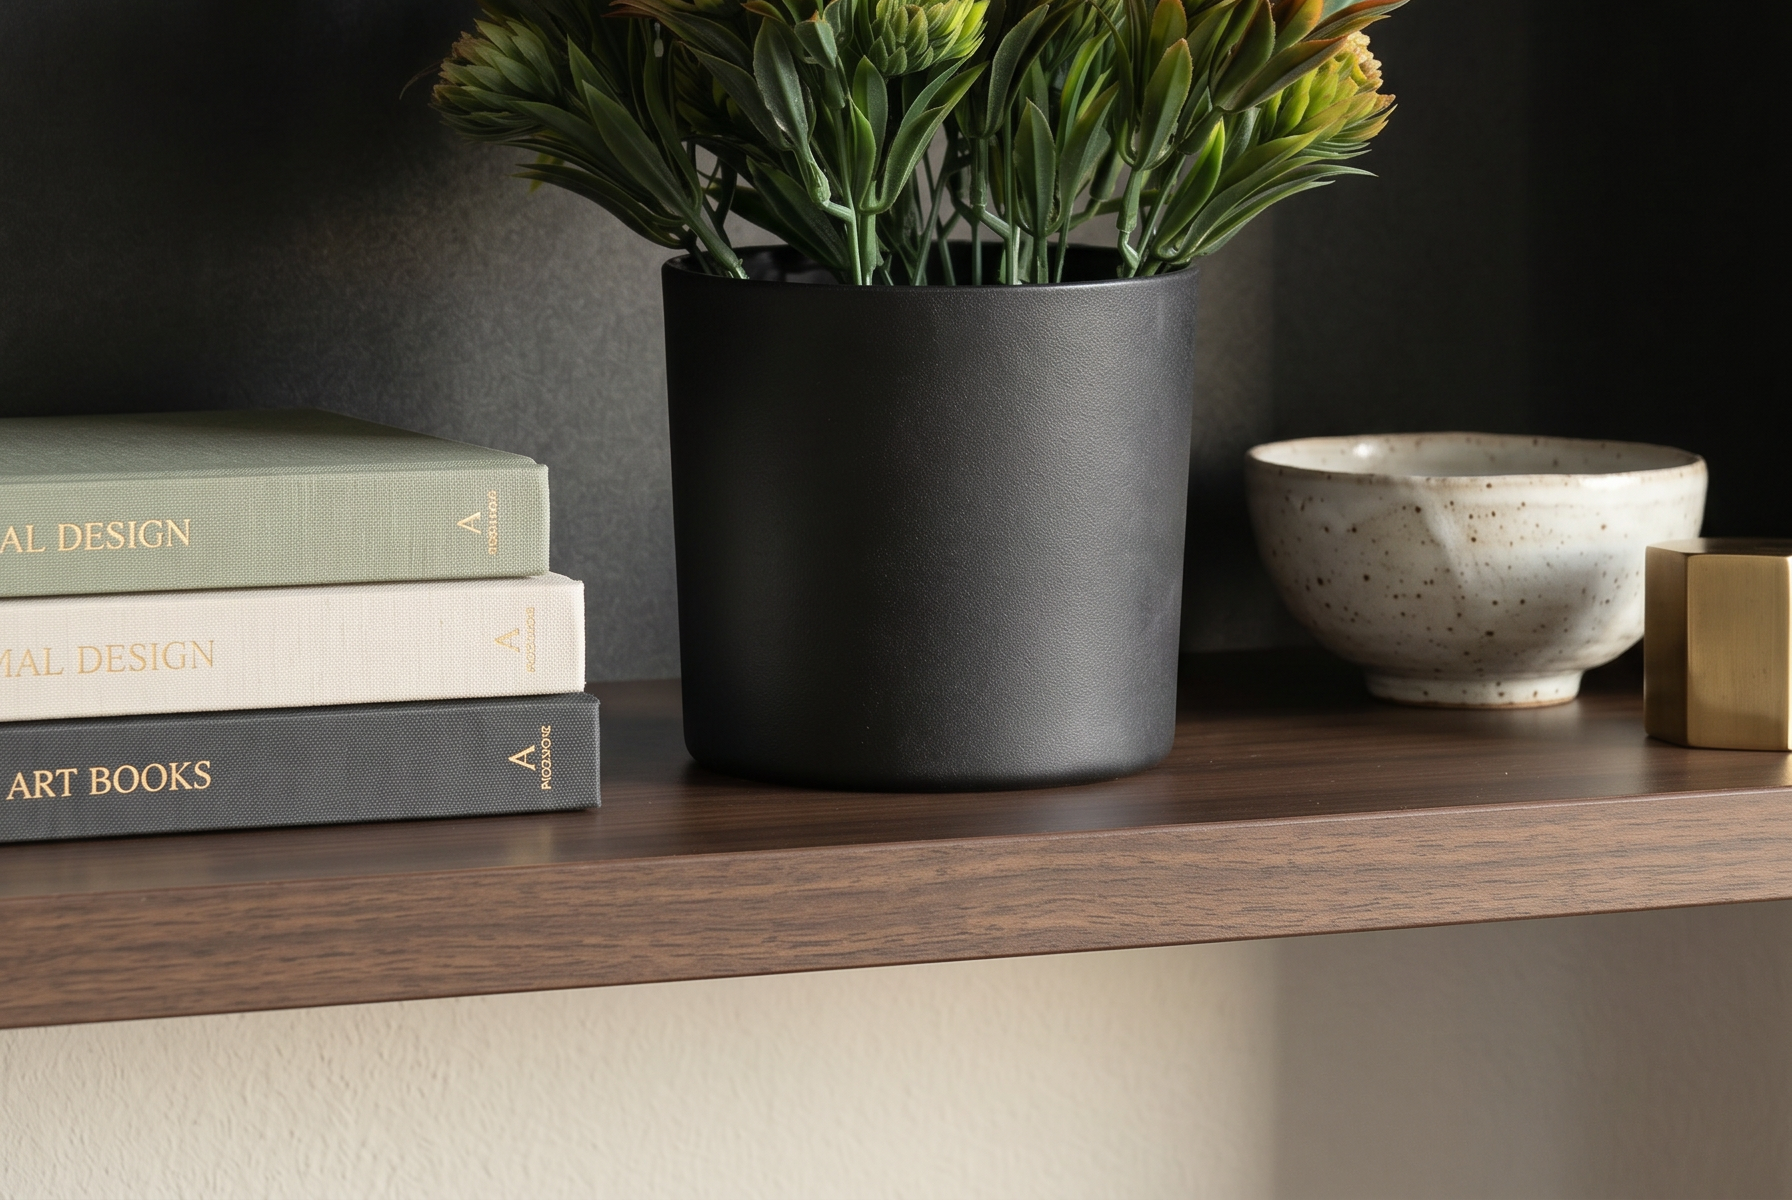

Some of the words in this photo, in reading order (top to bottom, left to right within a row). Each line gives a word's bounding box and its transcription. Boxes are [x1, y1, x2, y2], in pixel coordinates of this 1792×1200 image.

[0, 525, 46, 553] AL
[58, 518, 192, 552] DESIGN
[76, 639, 214, 674] DESIGN
[6, 767, 78, 800] ART
[89, 760, 212, 796] BOOKS
